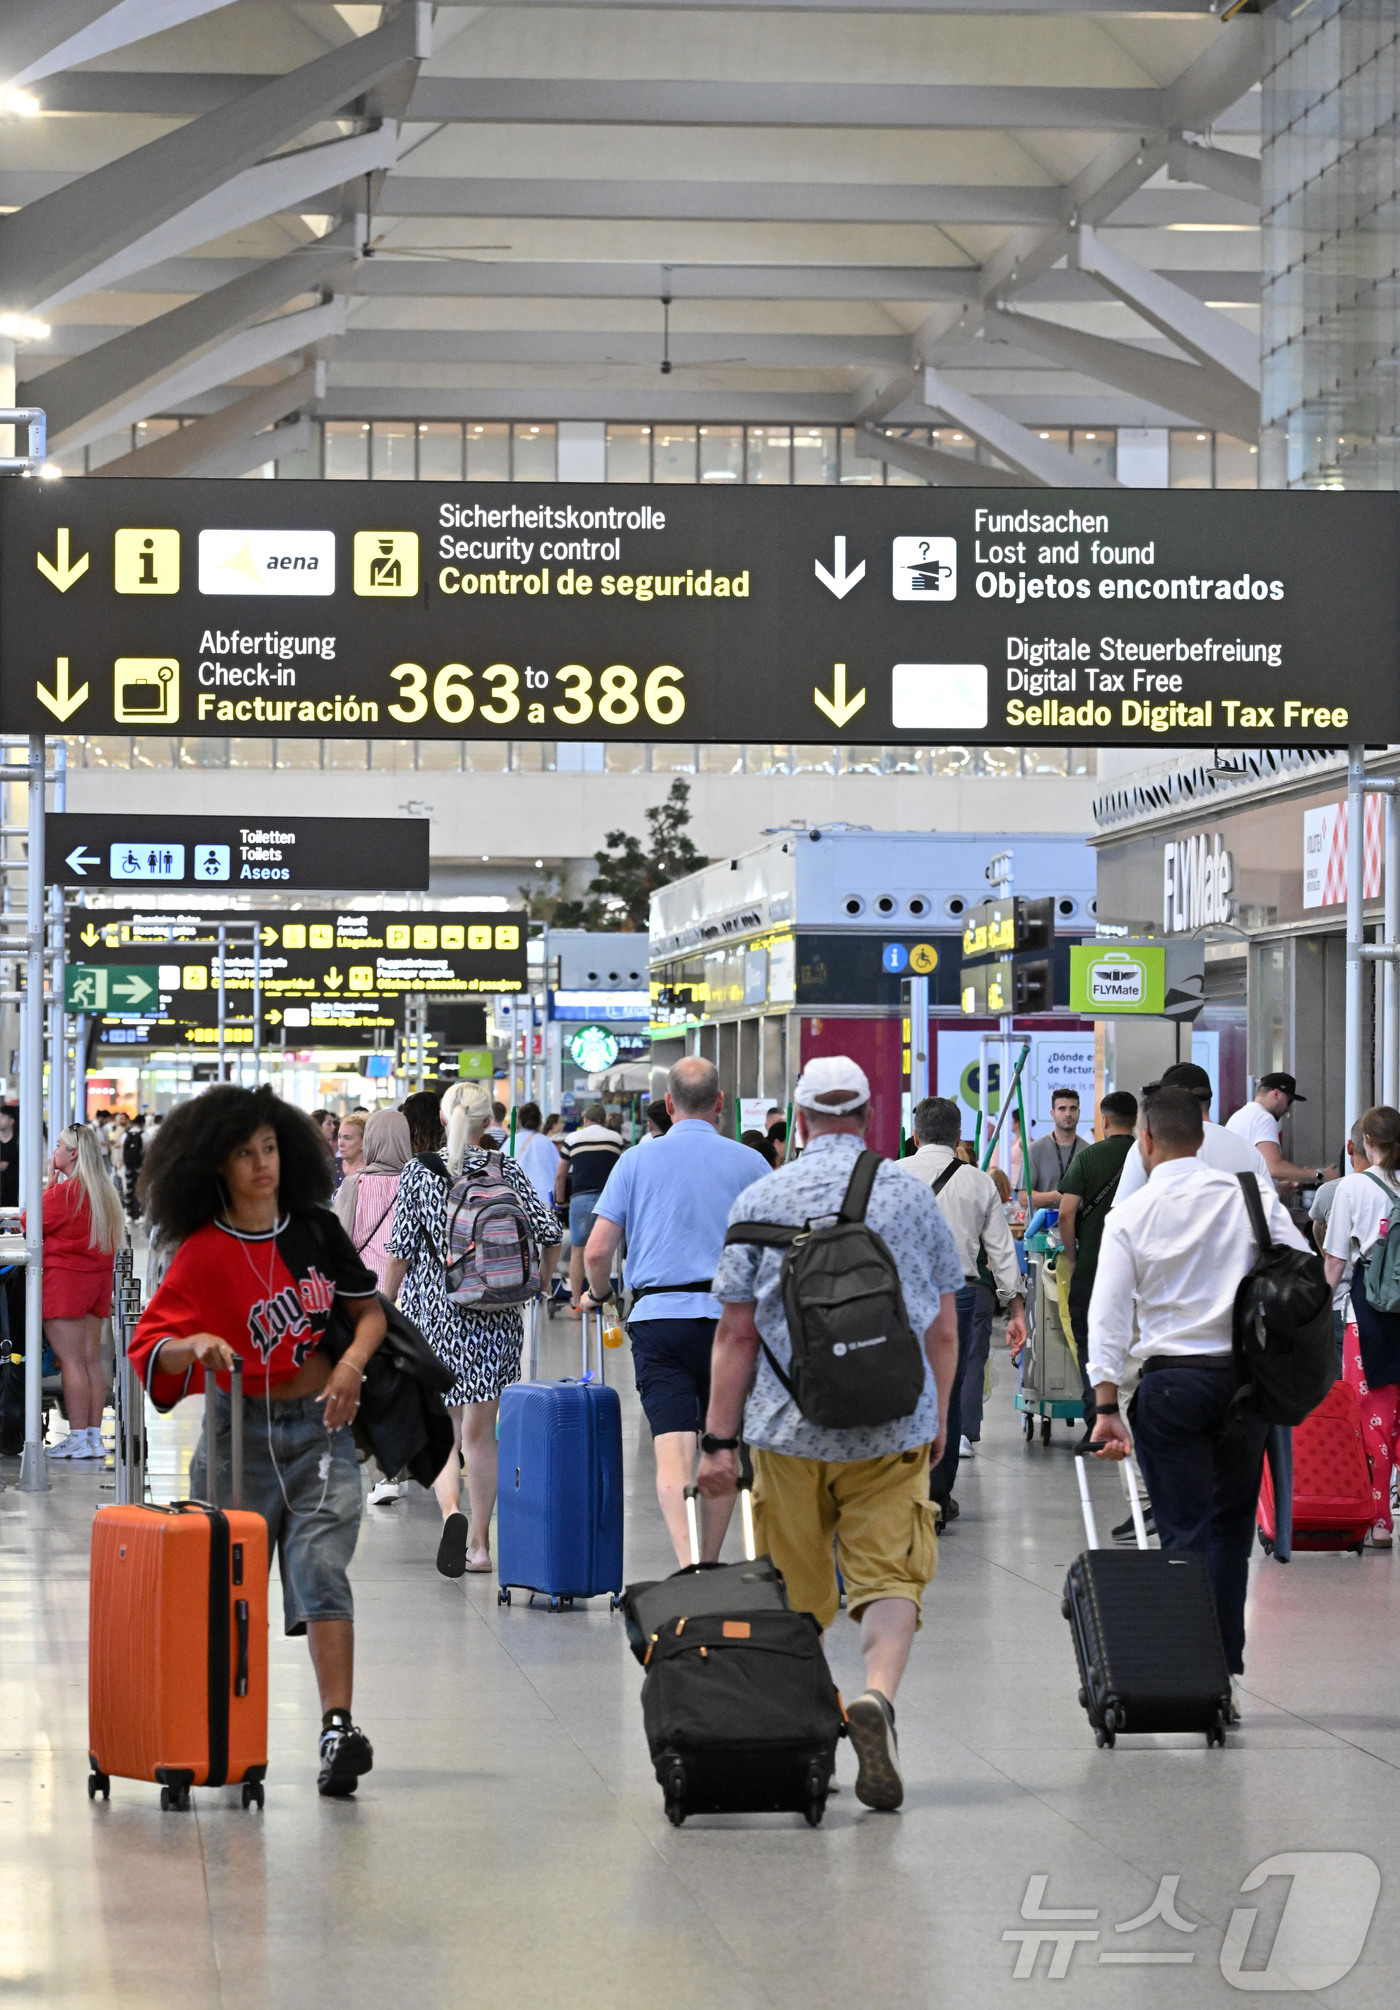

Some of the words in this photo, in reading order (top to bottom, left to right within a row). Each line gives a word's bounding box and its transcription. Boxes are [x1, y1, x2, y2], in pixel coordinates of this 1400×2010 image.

[439, 503, 665, 529] Sicherheitskontrolle
[975, 509, 1108, 533] Fundsachen
[439, 535, 534, 564] Security
[540, 537, 620, 560] control
[975, 540, 1026, 563] Lost
[1038, 541, 1079, 564] and
[1091, 540, 1154, 564] found
[267, 557, 318, 569] aena
[439, 567, 549, 594] Control
[557, 568, 592, 595] de
[601, 569, 749, 601] seguridad
[976, 571, 1090, 603] Objetos
[1099, 574, 1284, 600] encontrados
[199, 630, 336, 660] Abfertigung
[1007, 637, 1090, 666] Digitale
[1100, 637, 1282, 667] Steuerbefreiung
[199, 662, 295, 686] Check-in
[1007, 664, 1076, 696] Digital
[1084, 668, 1125, 691] Tax
[1134, 669, 1182, 692] Free
[199, 694, 378, 722] Facturación
[388, 663, 520, 723] 363
[525, 666, 548, 688] to
[553, 665, 685, 724] 386
[528, 703, 545, 723] a
[1006, 699, 1111, 726] Sellado
[1122, 700, 1212, 732] Digital
[1222, 701, 1274, 727] Tax
[1284, 701, 1348, 727] Free
[240, 829, 295, 844] Toiletten
[240, 846, 282, 861] Toilets
[240, 864, 290, 880] Aseos
[1164, 833, 1232, 934] FLYMate
[1093, 985, 1139, 996] FLYMate
[1048, 1052, 1084, 1063] ¿Dónde
[1048, 1065, 1060, 1074] de
